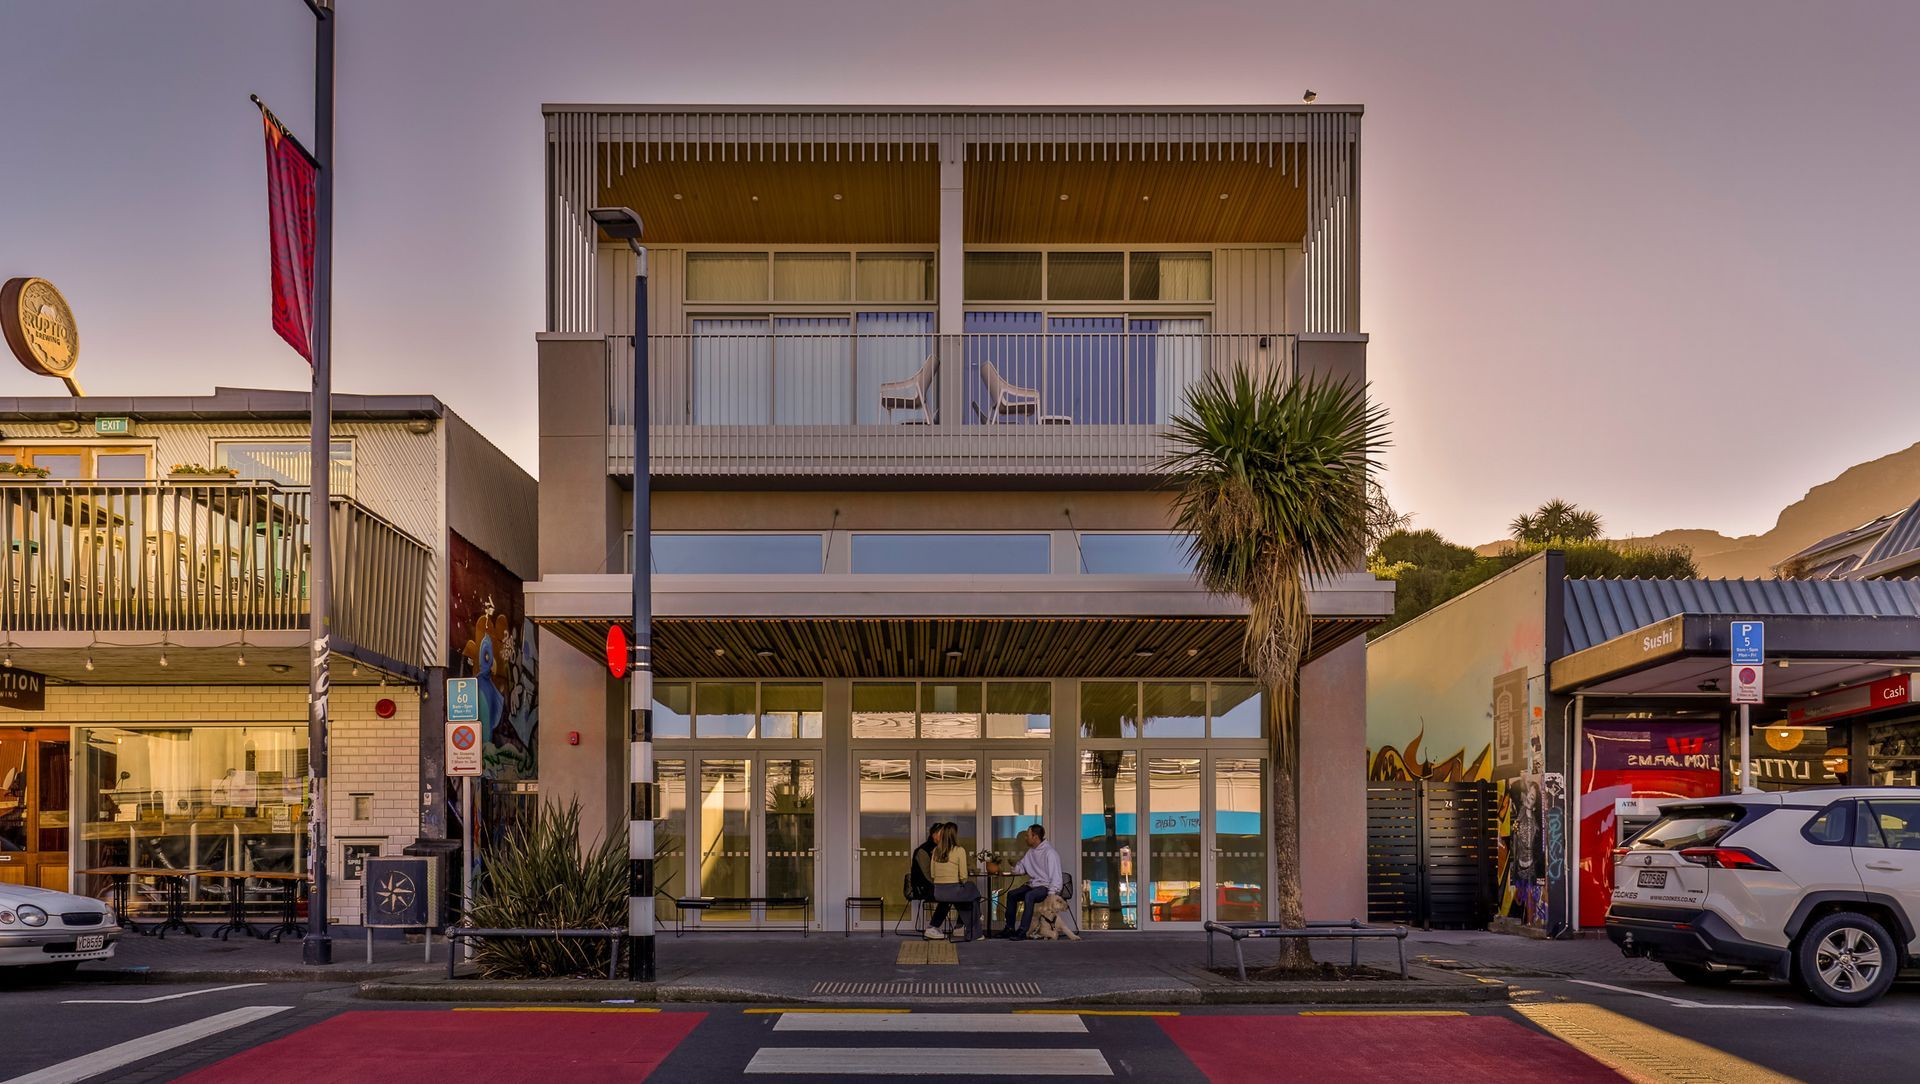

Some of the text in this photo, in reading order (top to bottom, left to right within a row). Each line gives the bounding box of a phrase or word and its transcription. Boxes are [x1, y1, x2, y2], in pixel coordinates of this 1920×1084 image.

[36, 331, 61, 346] BREWING
[101, 420, 121, 431] EXIT
[1742, 624, 1752, 637] P
[1643, 628, 1673, 652] Sushi
[1744, 637, 1750, 647] 5
[457, 681, 467, 693] P
[1883, 685, 1905, 700] Cash
[457, 693, 468, 704] 60
[1445, 800, 1453, 808] 24
